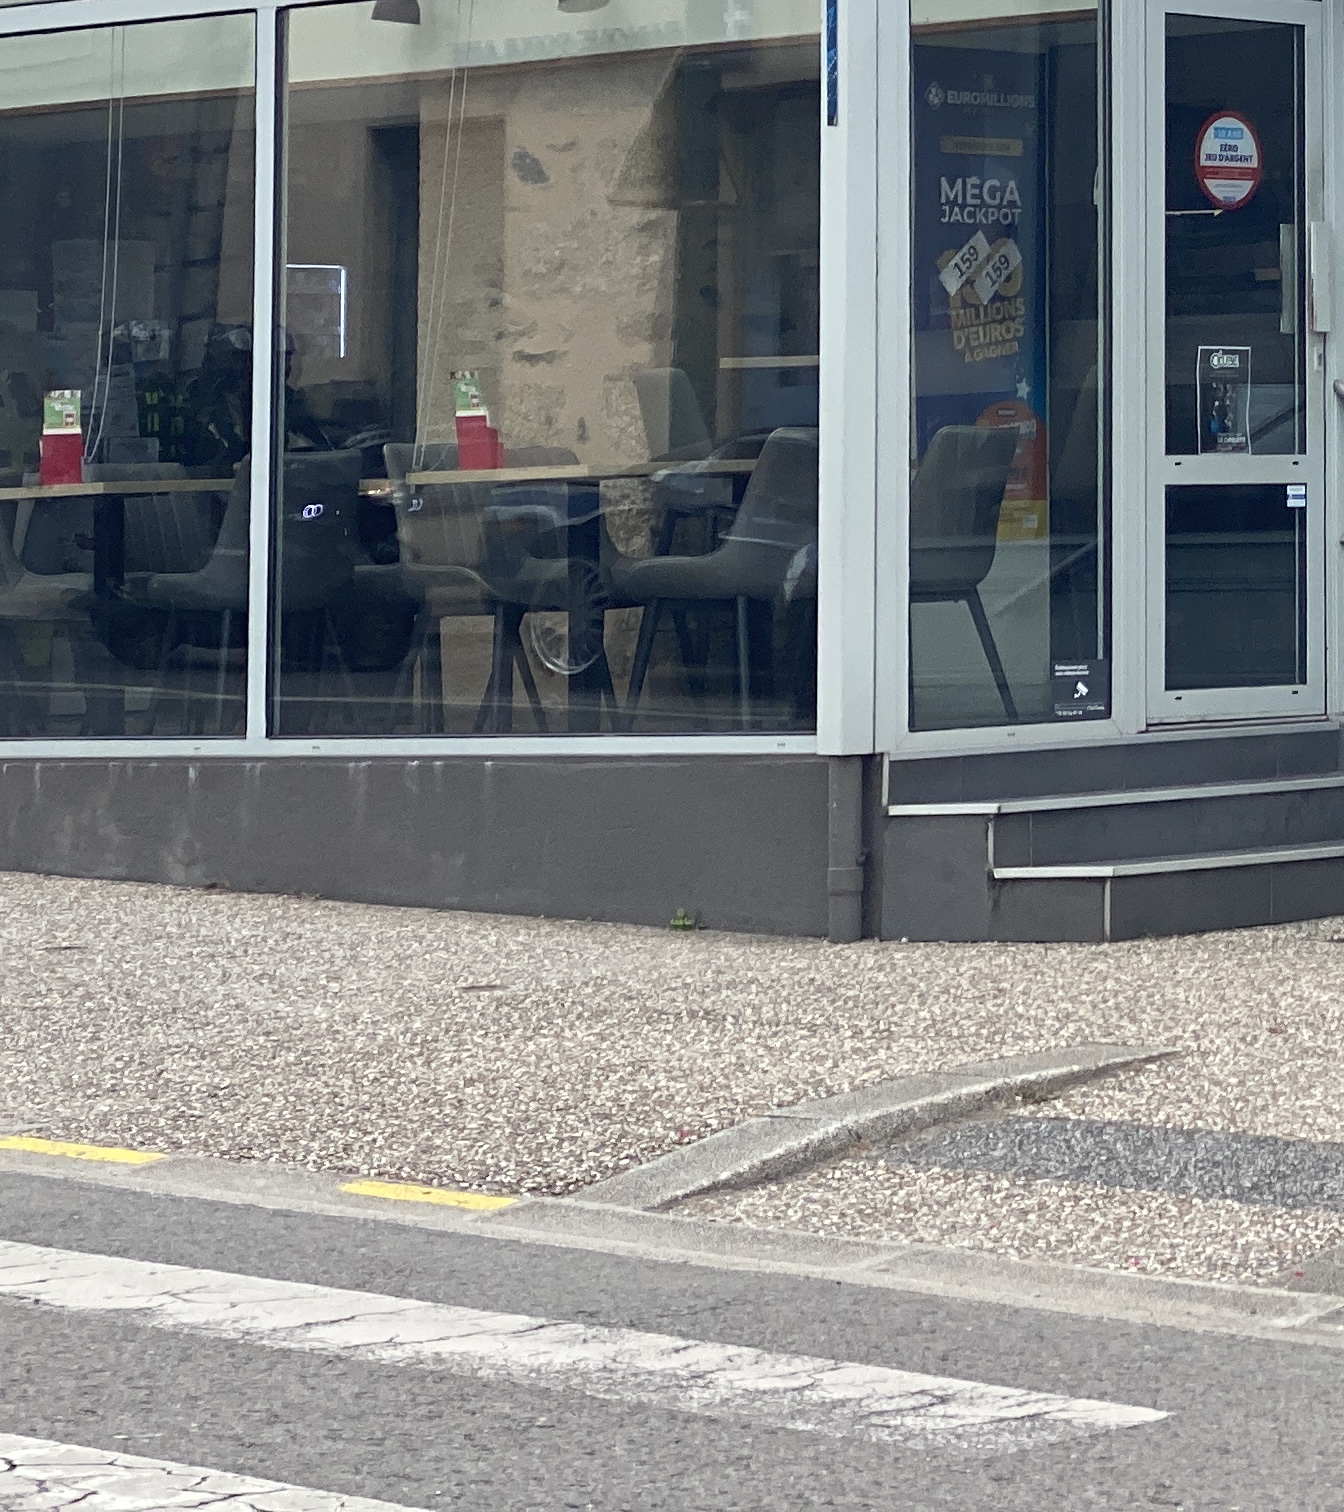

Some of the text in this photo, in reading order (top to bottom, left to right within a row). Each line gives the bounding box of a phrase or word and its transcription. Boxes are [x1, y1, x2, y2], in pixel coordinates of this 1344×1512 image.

[947, 89, 1036, 110] EUROMILLIONS
[940, 205, 1022, 226] JACKPOT
[953, 244, 979, 280] 159
[984, 252, 1011, 290] 159
[950, 297, 1025, 329] MILLIONS
[953, 319, 1025, 351] D'EUROS
